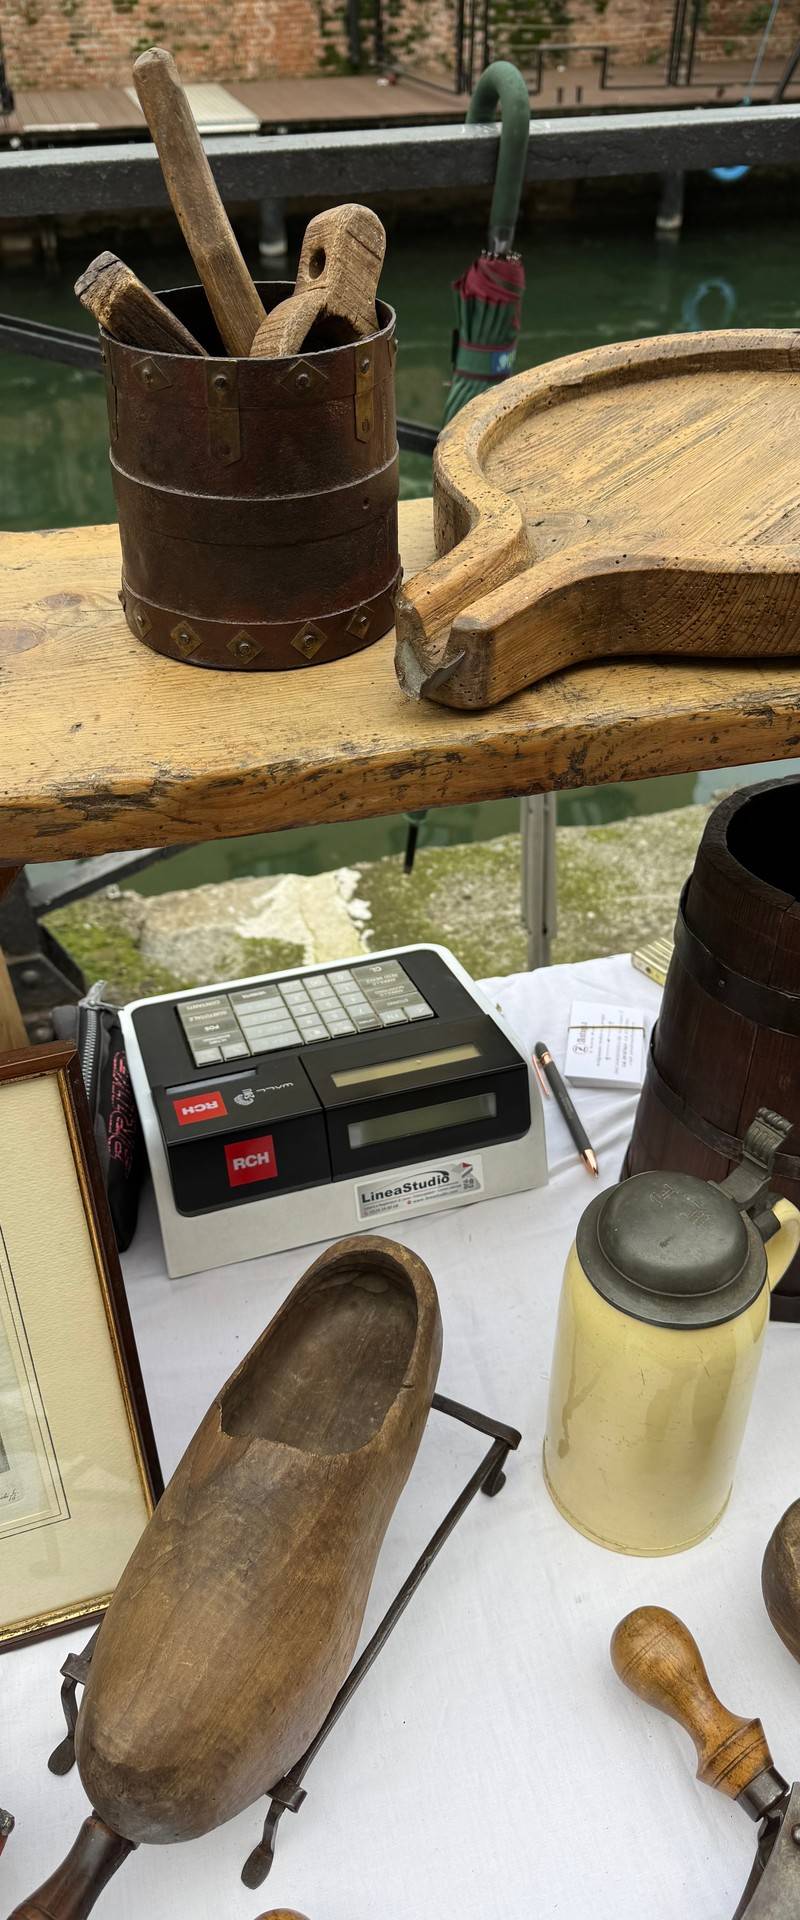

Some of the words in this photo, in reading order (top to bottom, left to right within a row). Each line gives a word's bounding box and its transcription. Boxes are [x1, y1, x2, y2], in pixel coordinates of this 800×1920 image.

[181, 1100, 219, 1116] RCH
[232, 1151, 270, 1171] RCH
[361, 1175, 450, 1204] LineaStudio
